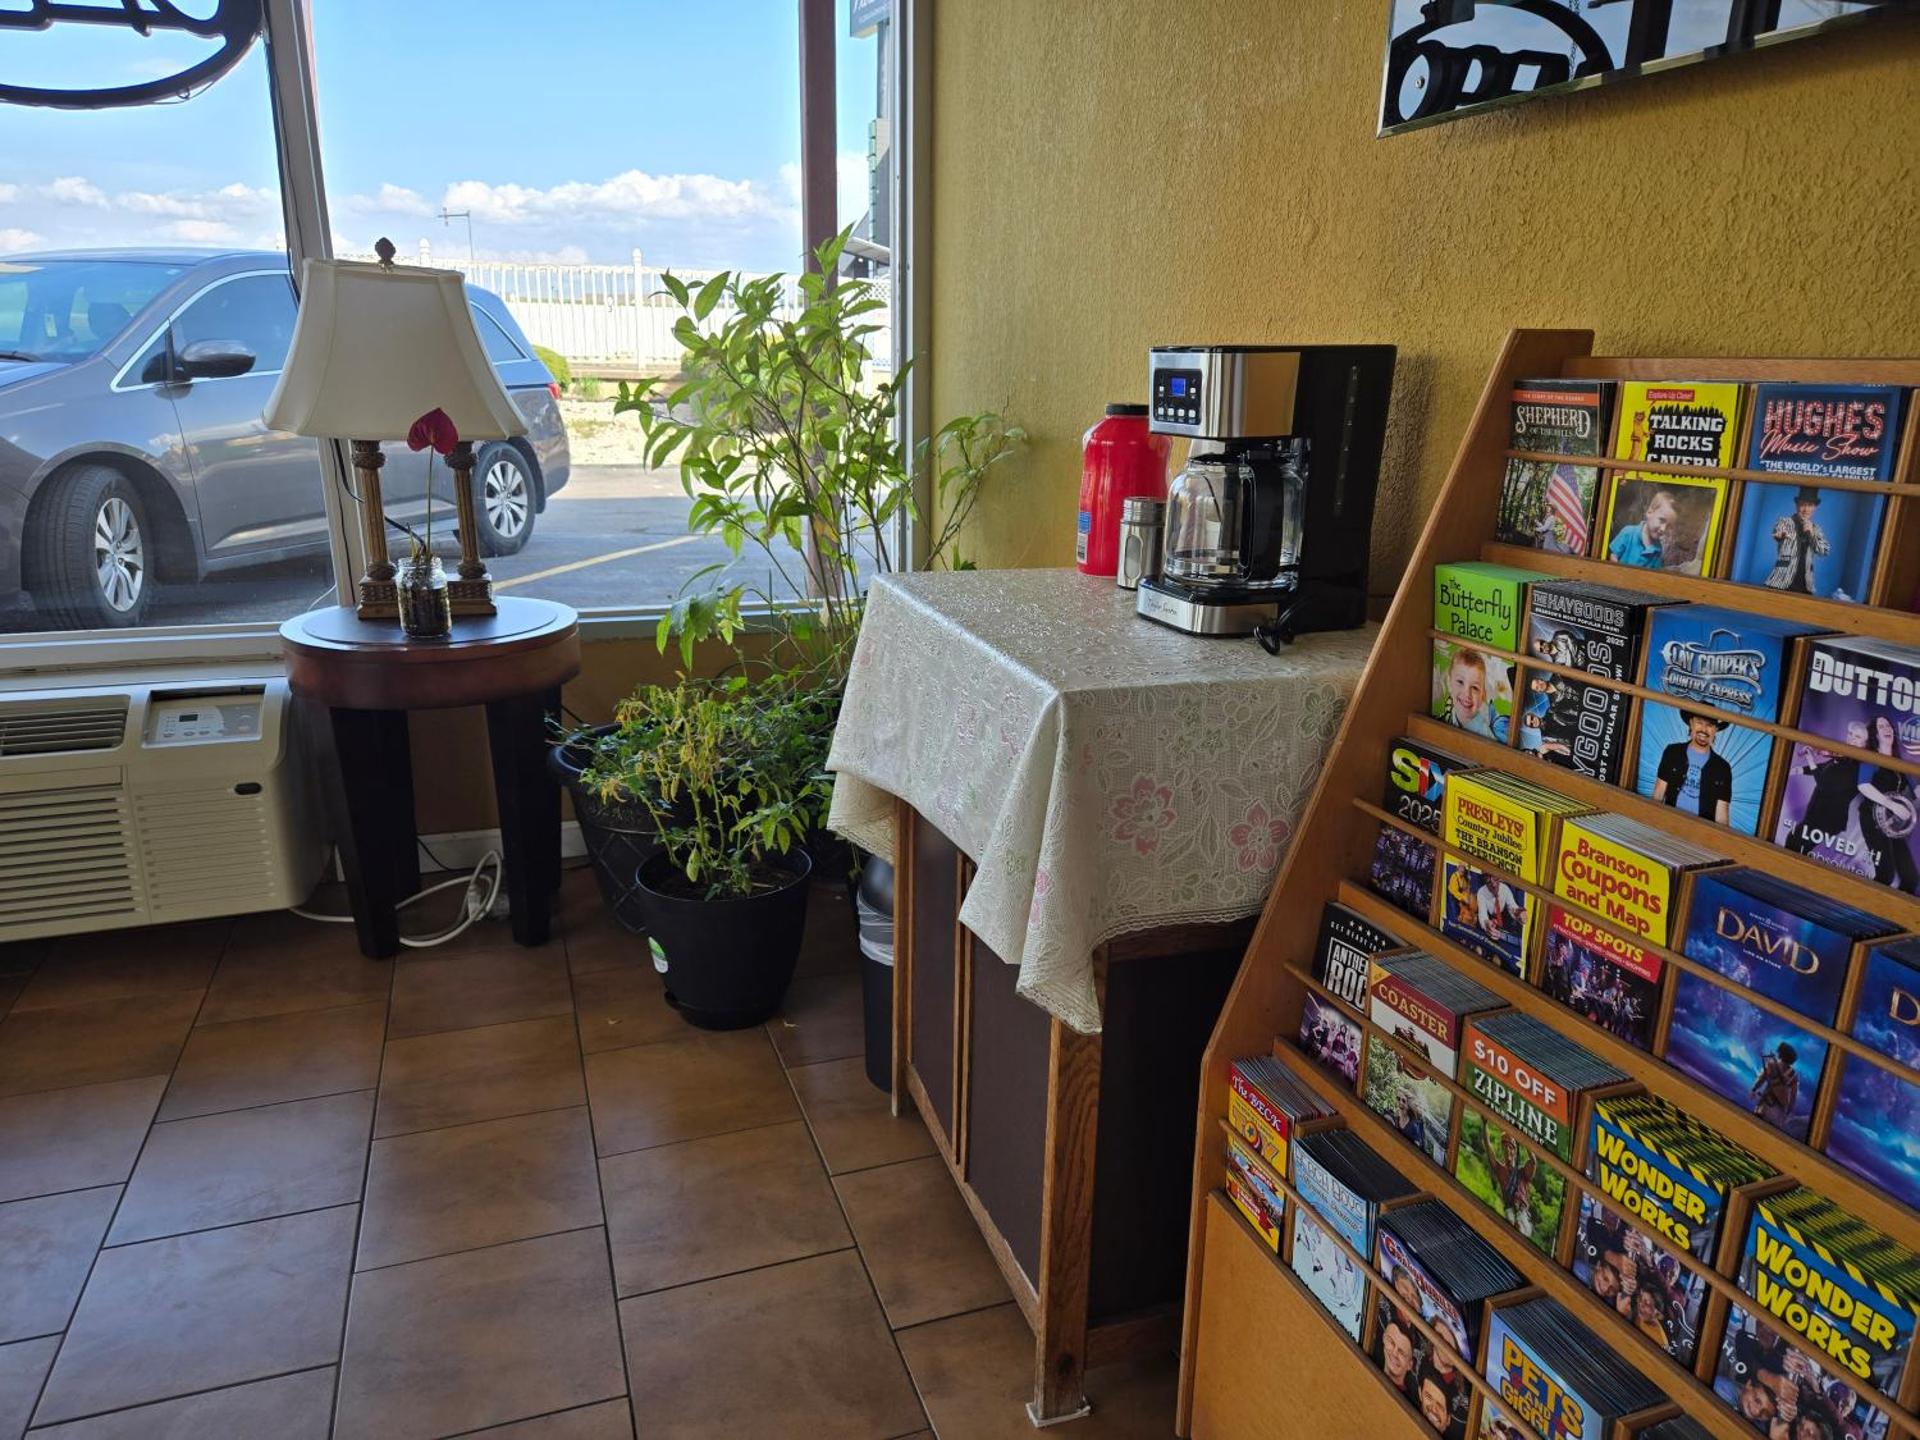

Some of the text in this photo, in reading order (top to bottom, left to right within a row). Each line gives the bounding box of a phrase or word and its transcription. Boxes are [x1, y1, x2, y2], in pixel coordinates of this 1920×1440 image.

[1515, 405, 1591, 438] SHEPHERD
[1649, 414, 1724, 432] TALKING
[1654, 434, 1715, 452] ROCKS
[1763, 400, 1886, 440] HUGHES
[1759, 429, 1880, 461] Music Show
[1829, 464, 1877, 476] LARGEST
[1440, 583, 1512, 632] Butterfly
[1450, 609, 1494, 642] Palace
[1548, 593, 1625, 628] HAYGOODS
[1602, 705, 1619, 757] POPULAR
[1391, 748, 1445, 801] SIX
[1399, 794, 1442, 834] 2025
[1457, 814, 1523, 851] Country Jubilee
[1456, 827, 1523, 867] THE BRANSON
[1577, 837, 1650, 886] Branson
[1801, 824, 1858, 856] LOVED
[1560, 849, 1662, 915] Coupons
[1566, 884, 1651, 936] and Map
[1563, 911, 1593, 936] TOP
[1594, 928, 1645, 963] SPOTS
[1716, 906, 1820, 975] DAVID
[1326, 959, 1368, 1011] ROC
[1379, 983, 1449, 1041] COASTER
[1474, 1039, 1556, 1105] $10 OFF
[1248, 1092, 1282, 1132] BECK
[1474, 1067, 1557, 1146] ZIPLINE
[1597, 1124, 1706, 1226] WONDER
[1600, 1162, 1691, 1251] WORKS
[1756, 1226, 1897, 1351] WONDER
[1757, 1269, 1872, 1380] WORKS
[1503, 1333, 1585, 1439] PETS
[1525, 1390, 1552, 1421] AND
